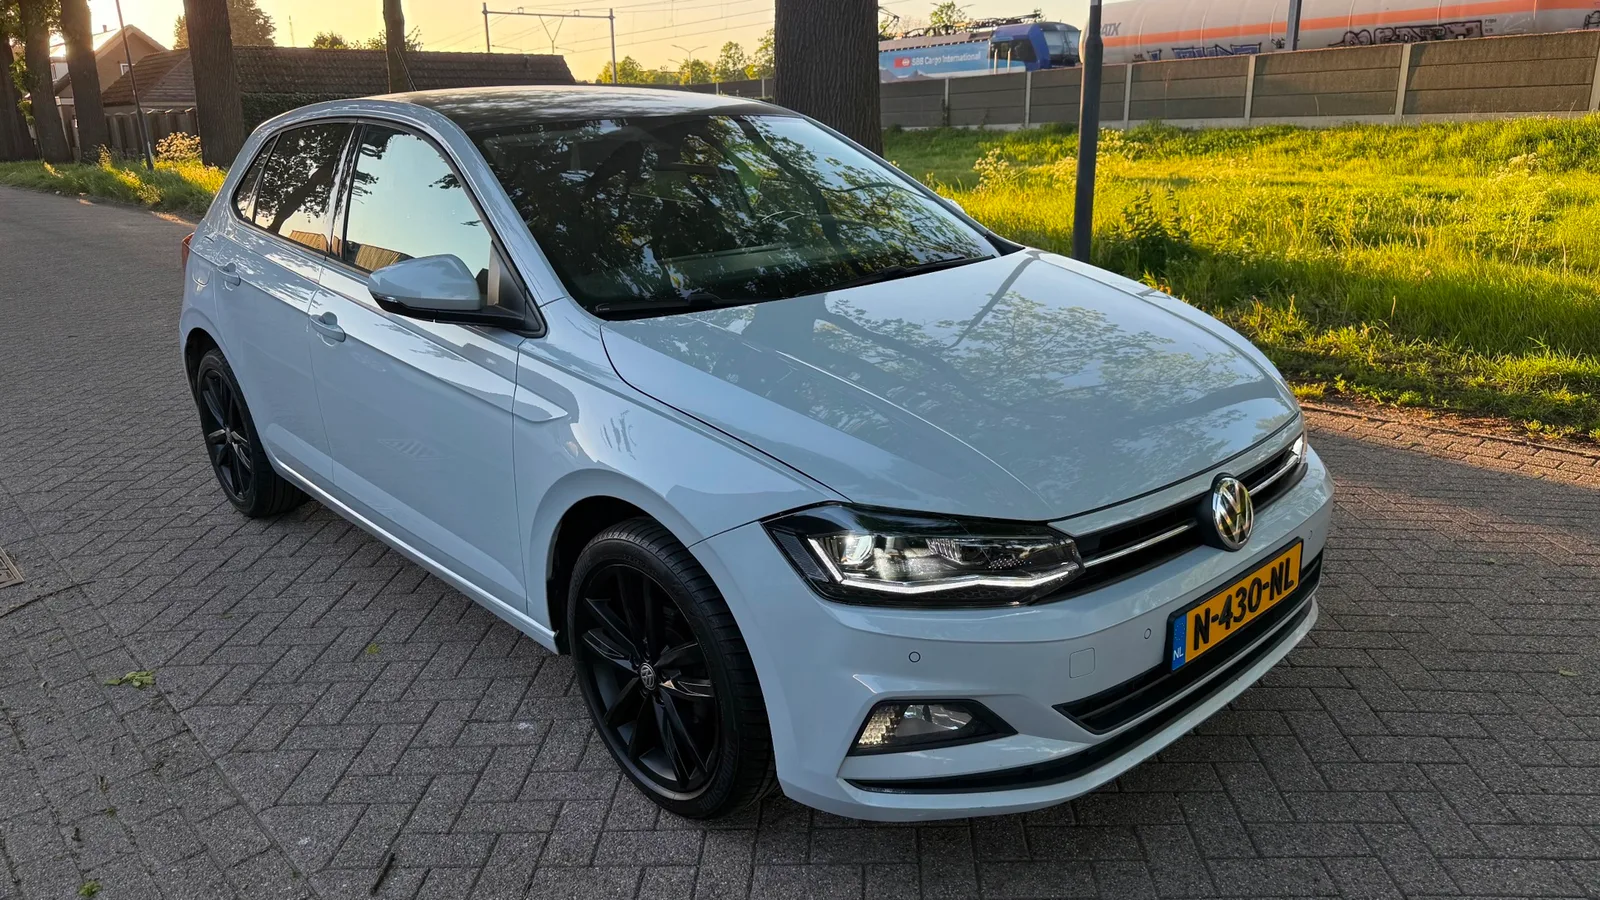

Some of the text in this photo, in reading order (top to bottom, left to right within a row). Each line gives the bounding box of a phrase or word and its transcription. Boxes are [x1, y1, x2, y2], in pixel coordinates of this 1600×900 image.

[1101, 22, 1121, 37] ATX
[911, 51, 981, 66] SBB Cargo International
[1193, 557, 1295, 651] N-430-NL
[1173, 646, 1184, 661] NL
